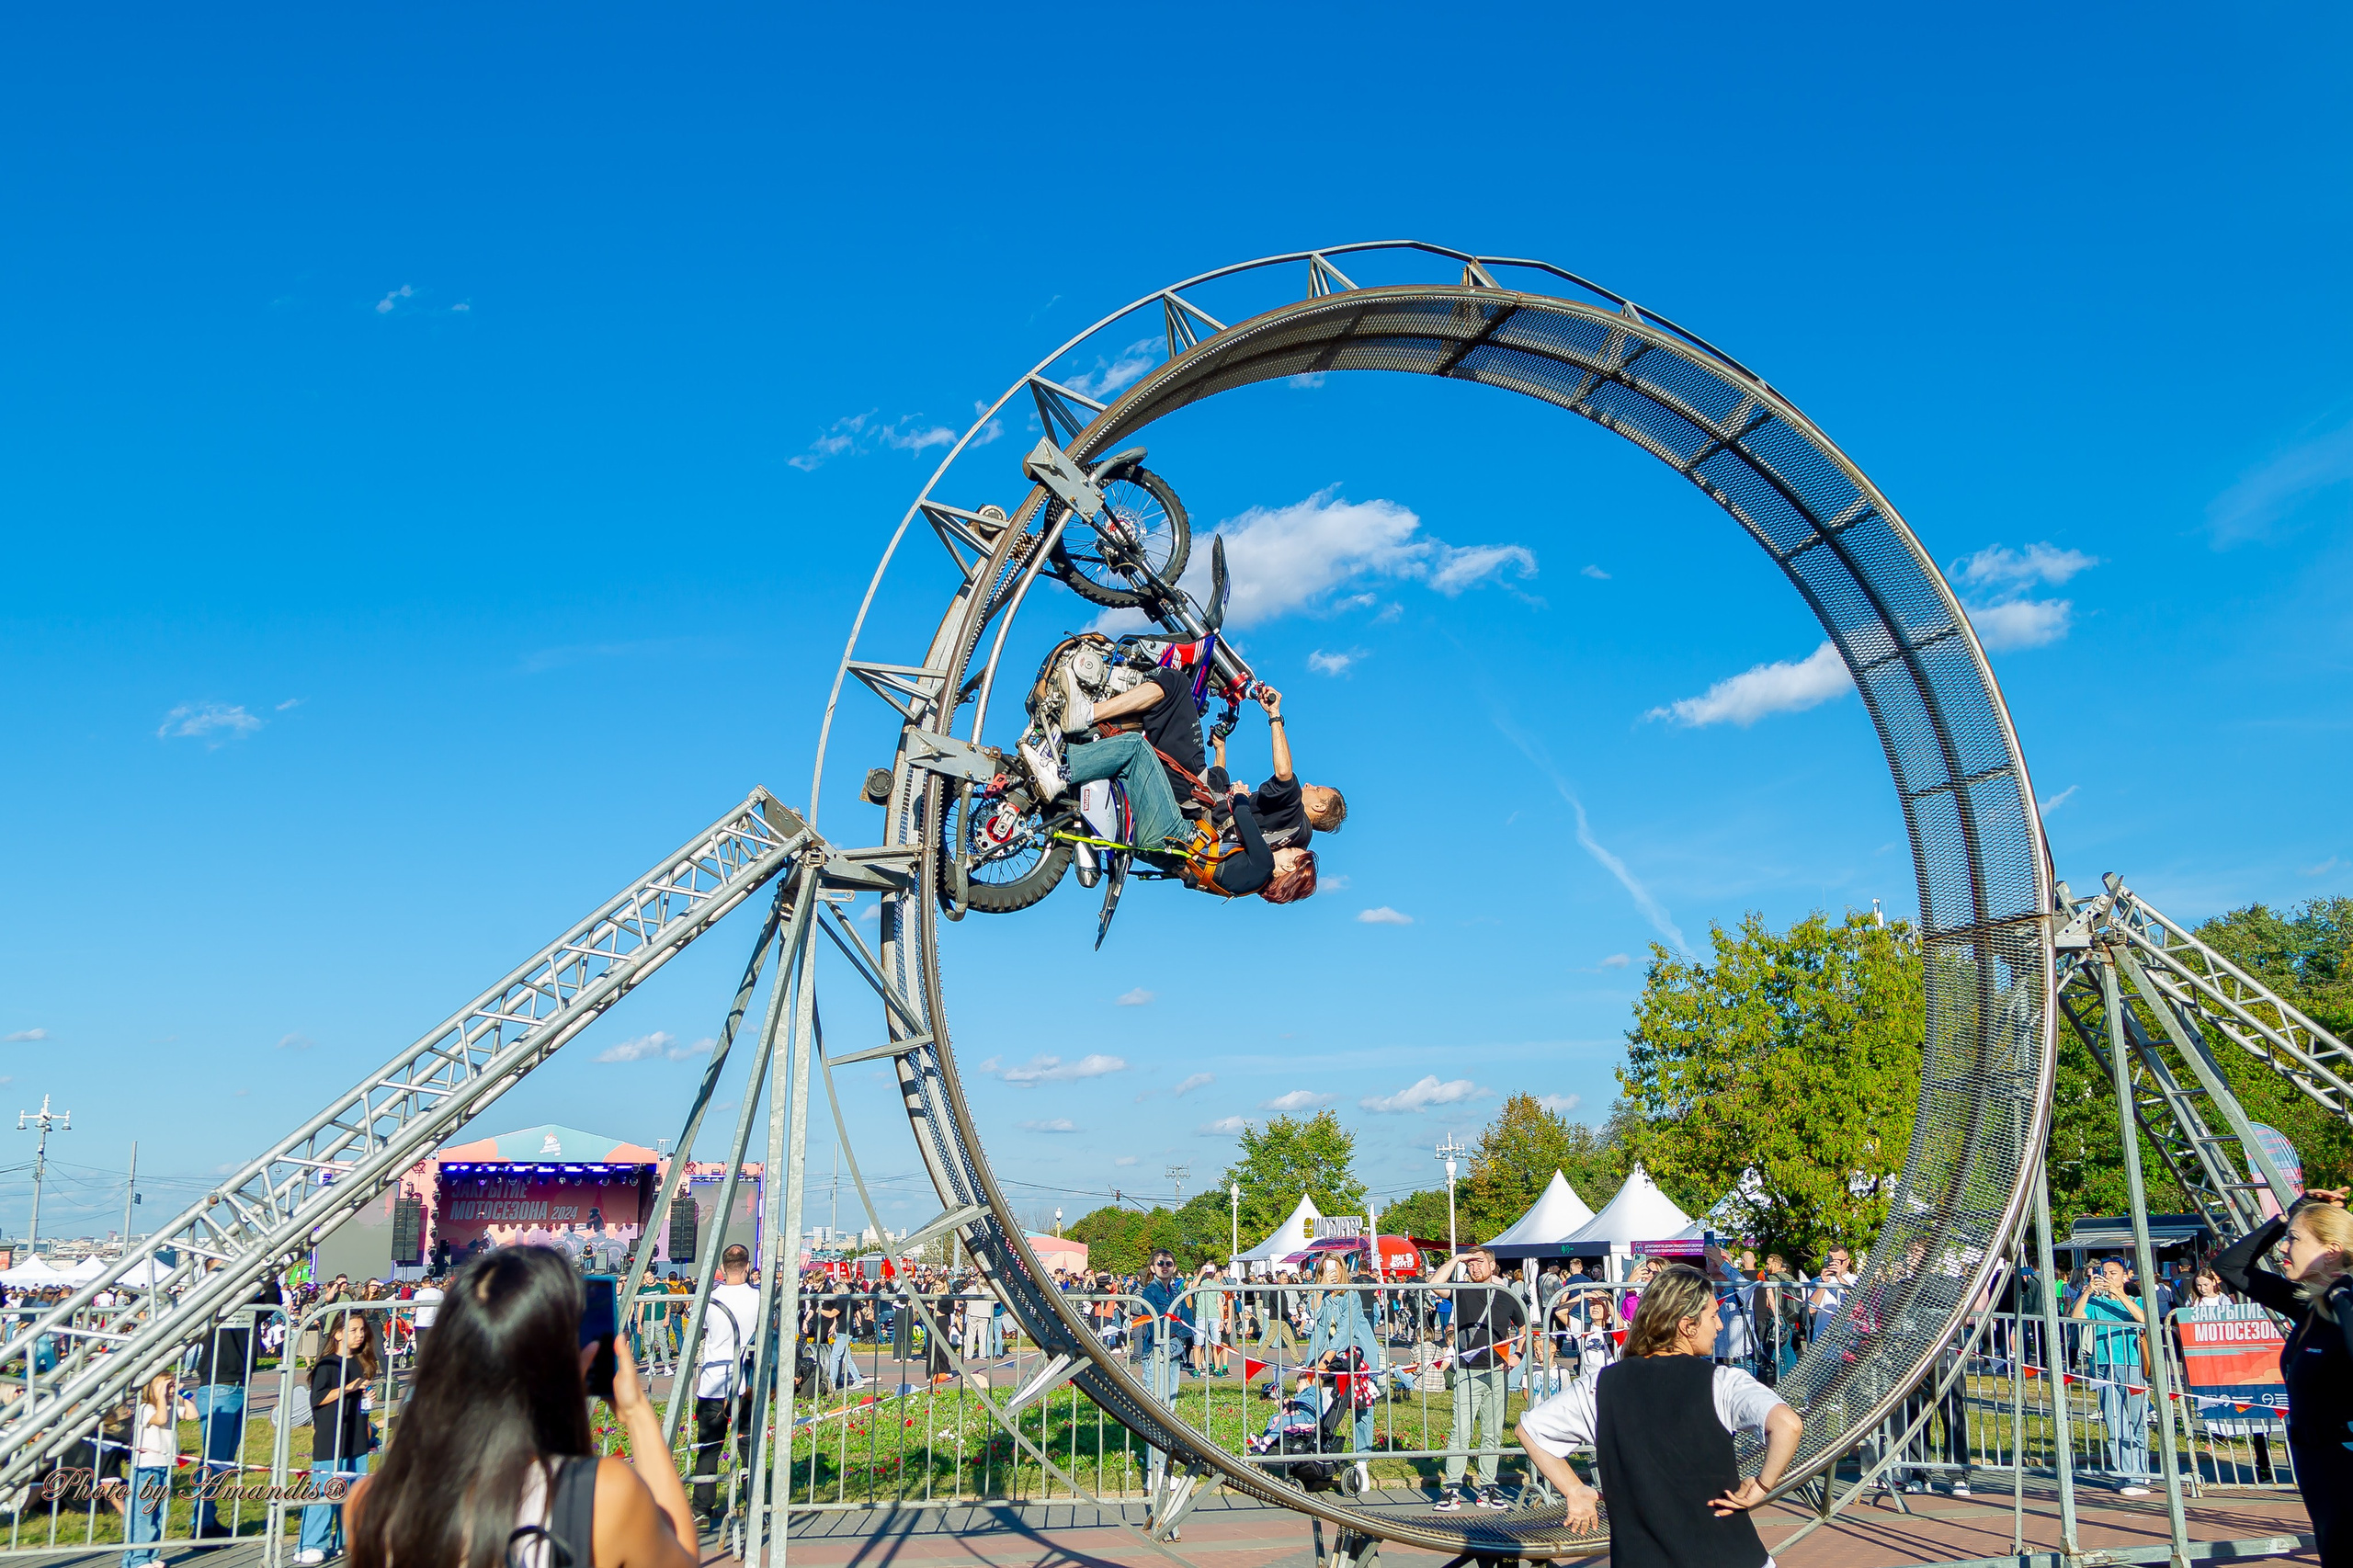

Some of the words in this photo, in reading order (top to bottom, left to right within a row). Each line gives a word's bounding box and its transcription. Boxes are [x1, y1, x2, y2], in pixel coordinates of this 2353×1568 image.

[451, 1179, 528, 1199] ЗАКРЫТИЕ
[449, 1200, 548, 1221] МОТОСЕЗОНА
[550, 1206, 579, 1220] 2024
[2190, 1303, 2265, 1322] ЗАКРЫТИЕ
[2194, 1321, 2283, 1342] МОТОСЕЗОН
